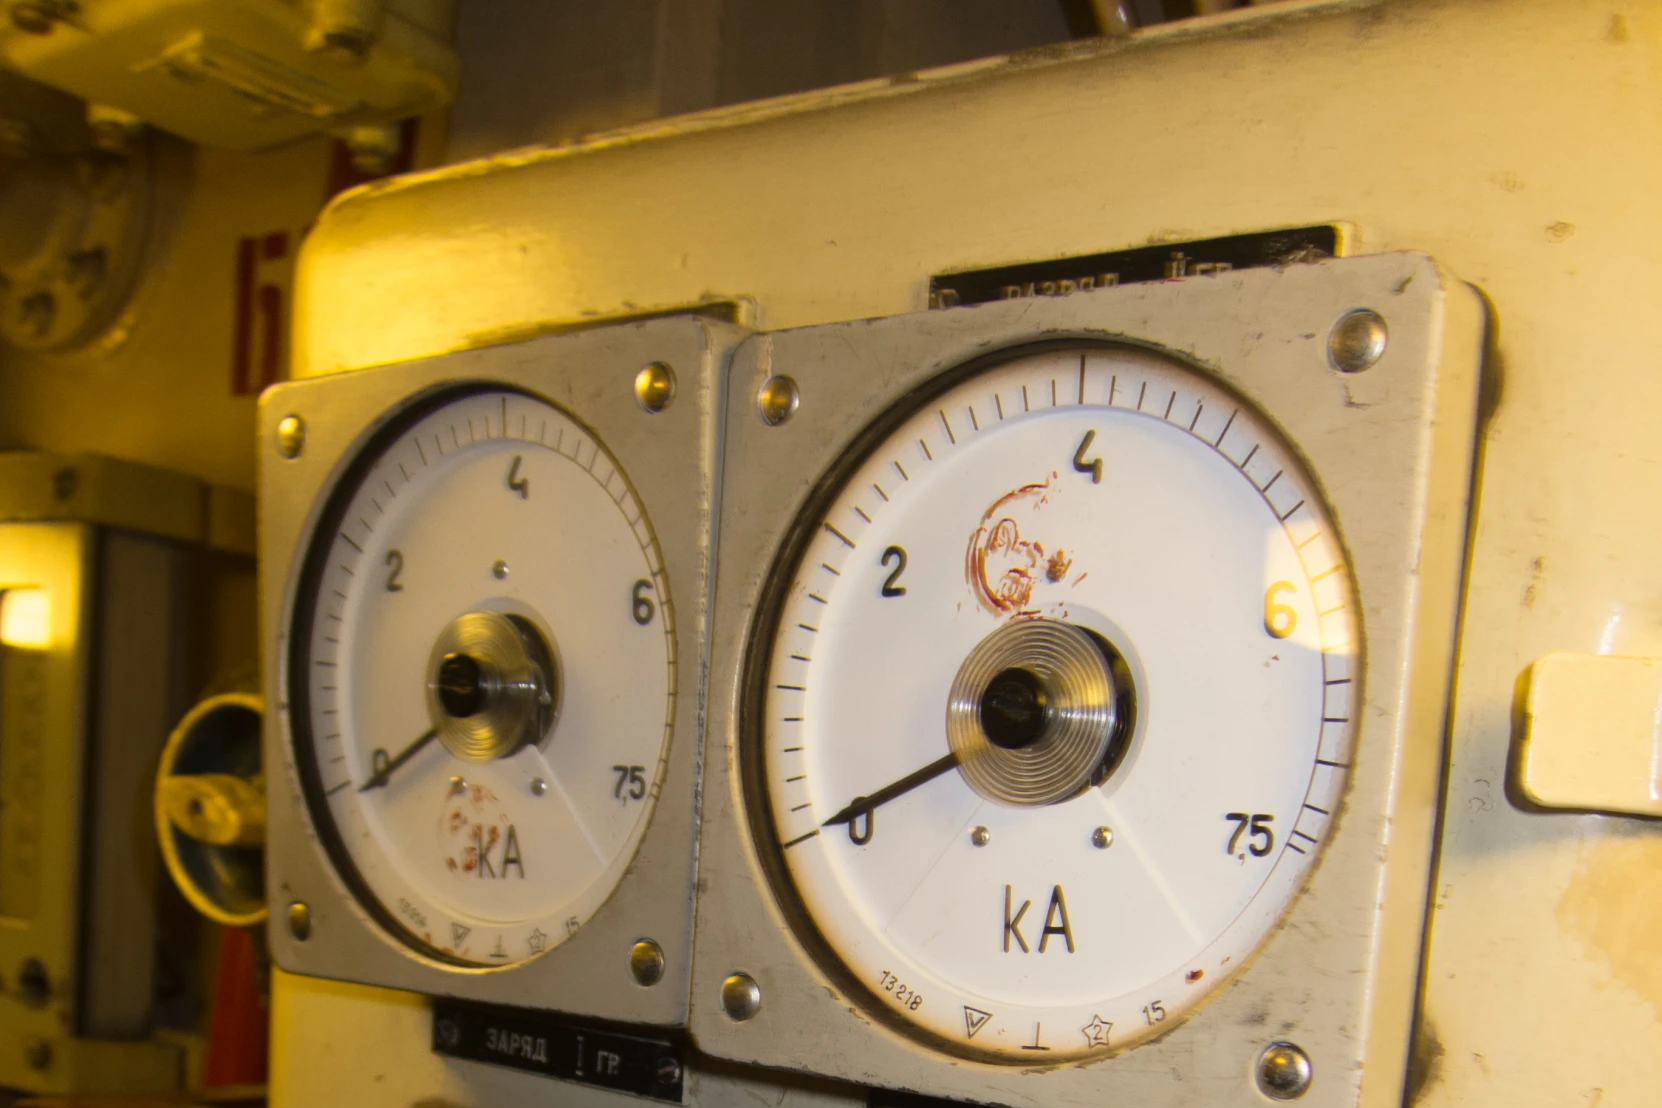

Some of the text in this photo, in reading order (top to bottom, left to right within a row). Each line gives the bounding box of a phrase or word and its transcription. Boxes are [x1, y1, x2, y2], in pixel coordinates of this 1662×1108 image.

[507, 456, 528, 498] 4
[1073, 430, 1102, 484] 4
[385, 550, 404, 592] 2
[880, 545, 907, 597] 2
[631, 579, 654, 625] 6
[1264, 580, 1297, 638] 6
[848, 796, 874, 845] 0
[880, 970, 923, 1011] 13218
[486, 1028, 548, 1063] ЗАРЯД
